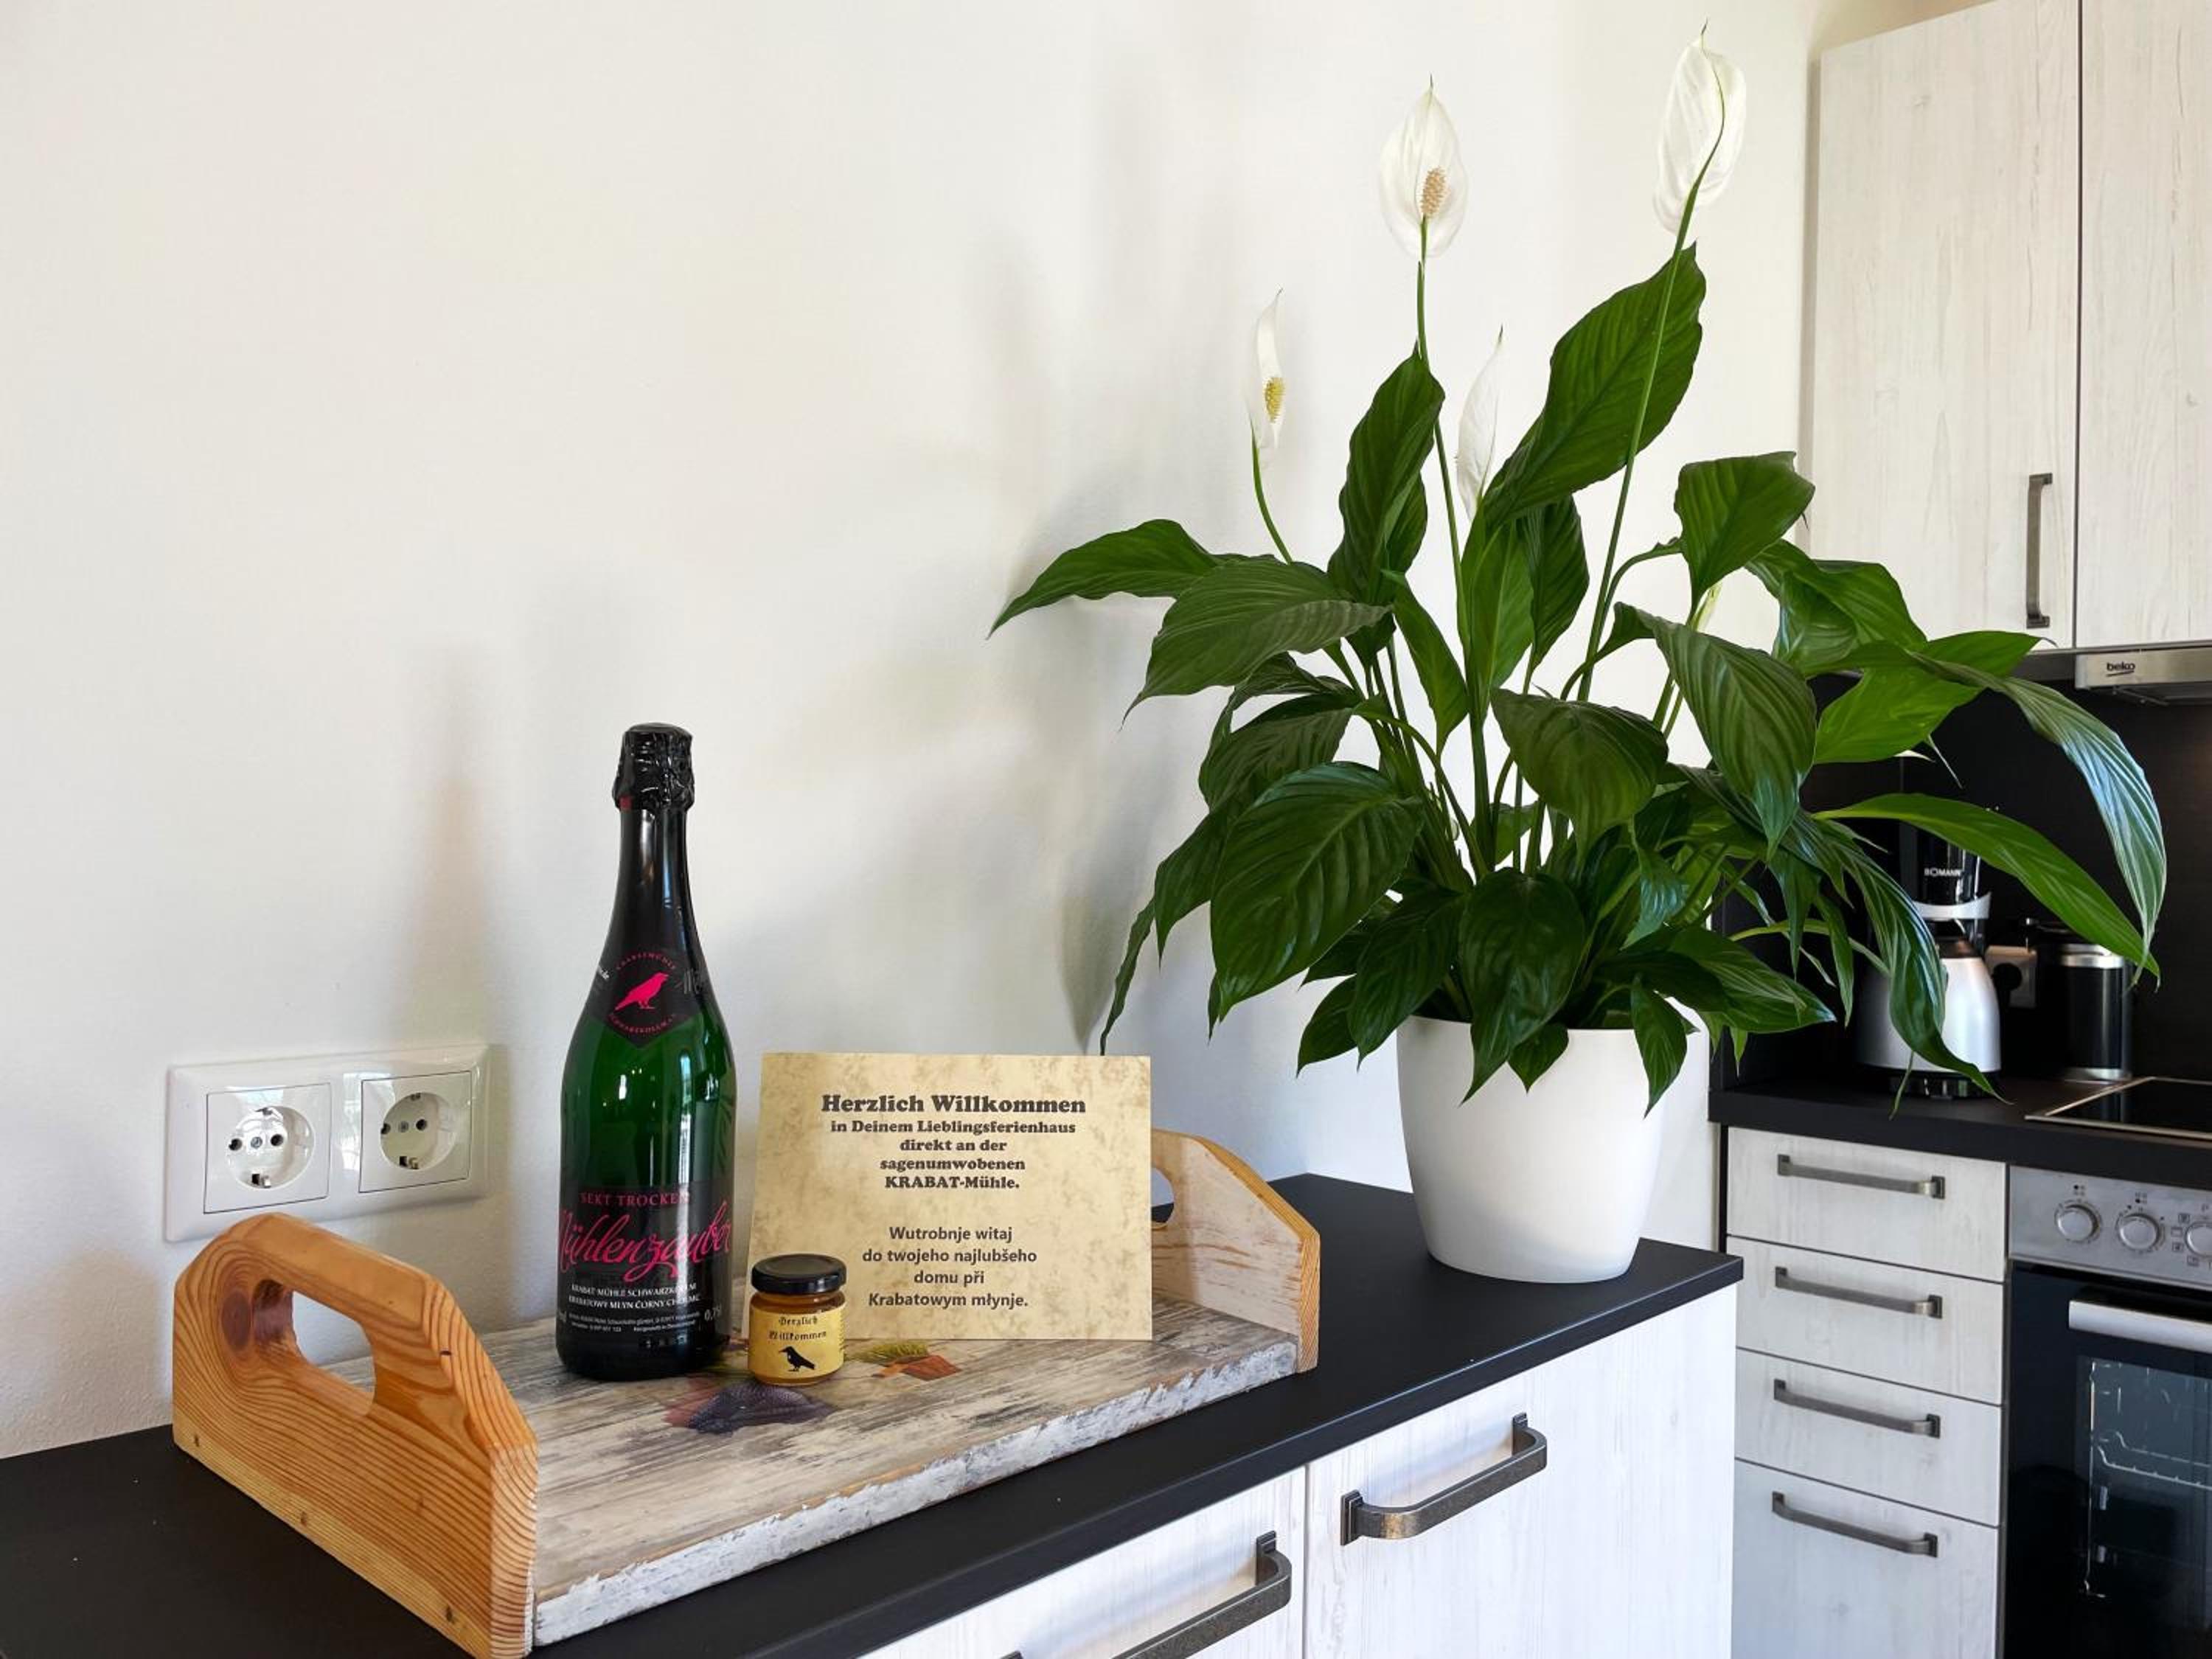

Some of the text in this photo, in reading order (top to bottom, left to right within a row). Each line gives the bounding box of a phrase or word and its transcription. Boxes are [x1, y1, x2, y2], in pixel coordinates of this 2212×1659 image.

[821, 1095, 1086, 1113] Herzlich Willkommen
[831, 1120, 1076, 1135] in Deinem Lieblingsferienhaus
[900, 1139, 1007, 1151] direkt an der
[880, 1158, 1026, 1171] sagenumwobenen
[885, 1176, 1020, 1189] KRABAT-Mühle.
[580, 1192, 611, 1205] SEKT
[889, 1226, 1012, 1243] Wutrobnje witaj
[862, 1248, 1037, 1265] do twojeho najlubšeho
[914, 1270, 984, 1287] domu při
[869, 1292, 1028, 1310] Krabatowym młynje.
